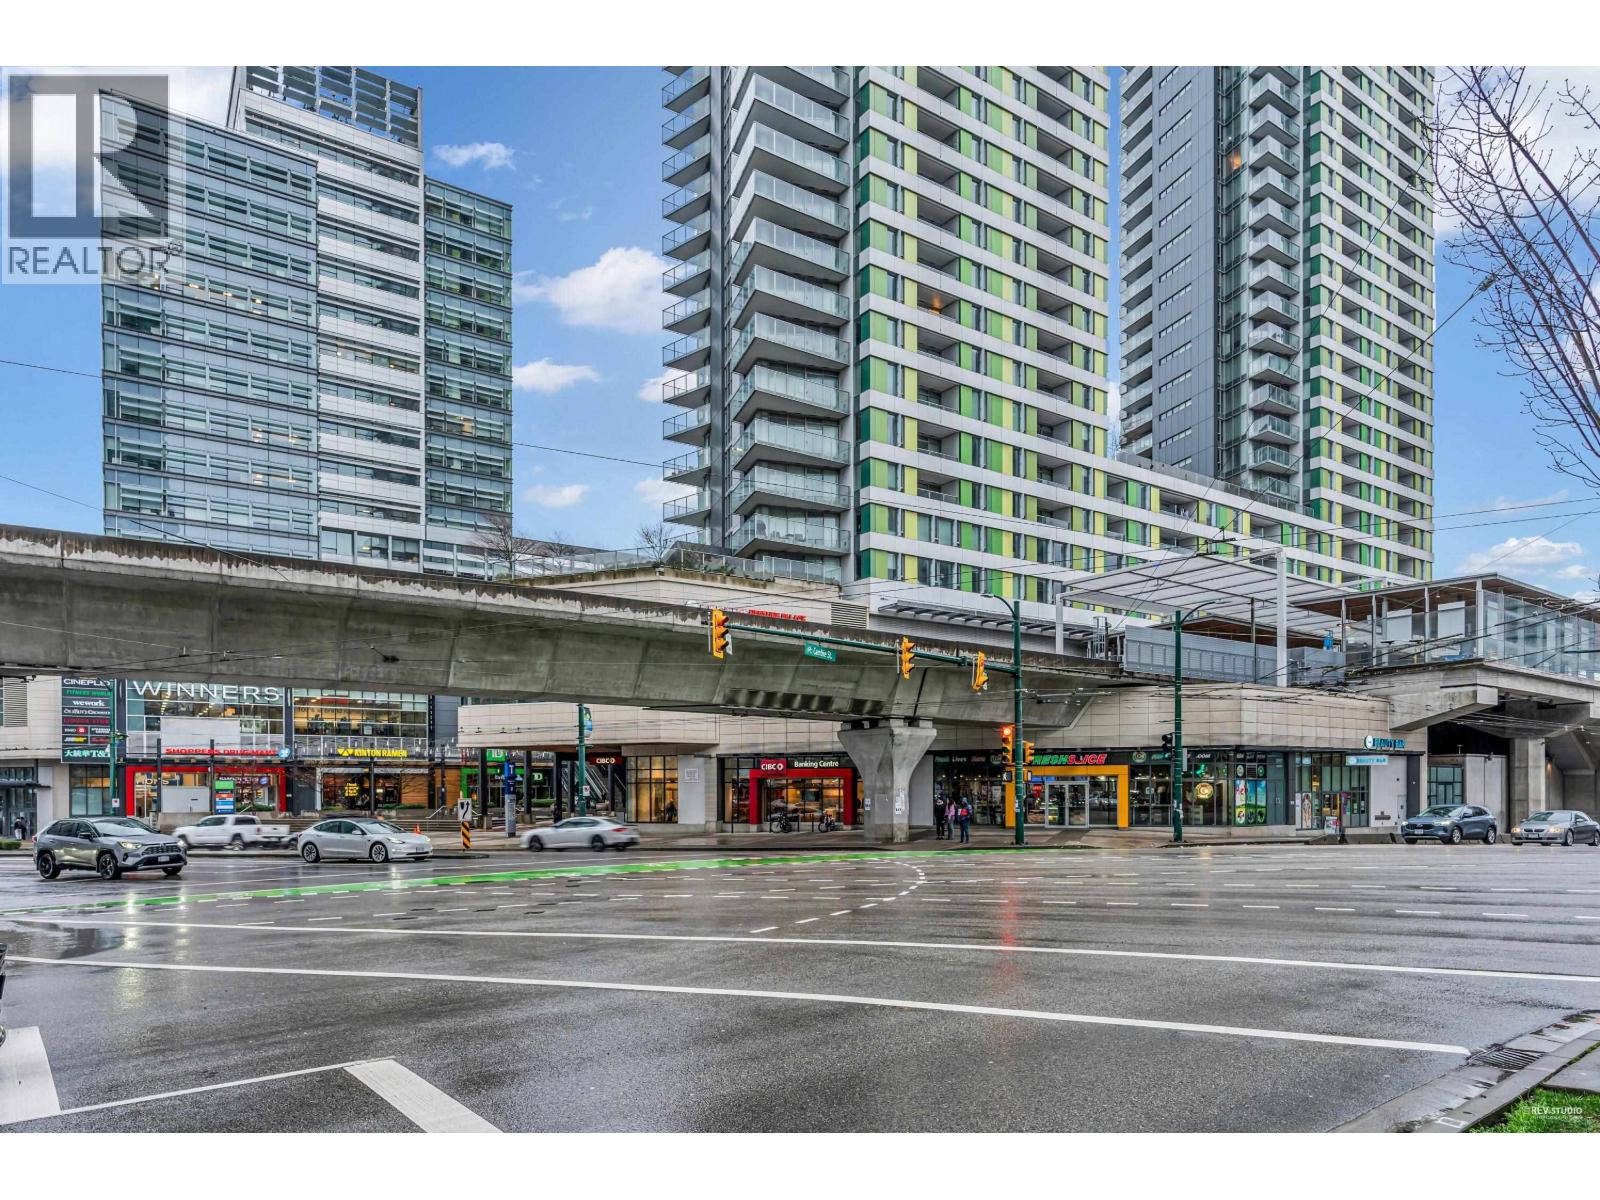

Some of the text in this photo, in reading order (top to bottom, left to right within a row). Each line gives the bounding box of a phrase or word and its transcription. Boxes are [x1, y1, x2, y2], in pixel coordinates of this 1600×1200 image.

[133, 681, 280, 701] WINNERS
[354, 749, 408, 758] KINTON RAMEN
[491, 749, 504, 758] TD
[794, 760, 818, 768] Banking
[532, 772, 543, 781] TD
